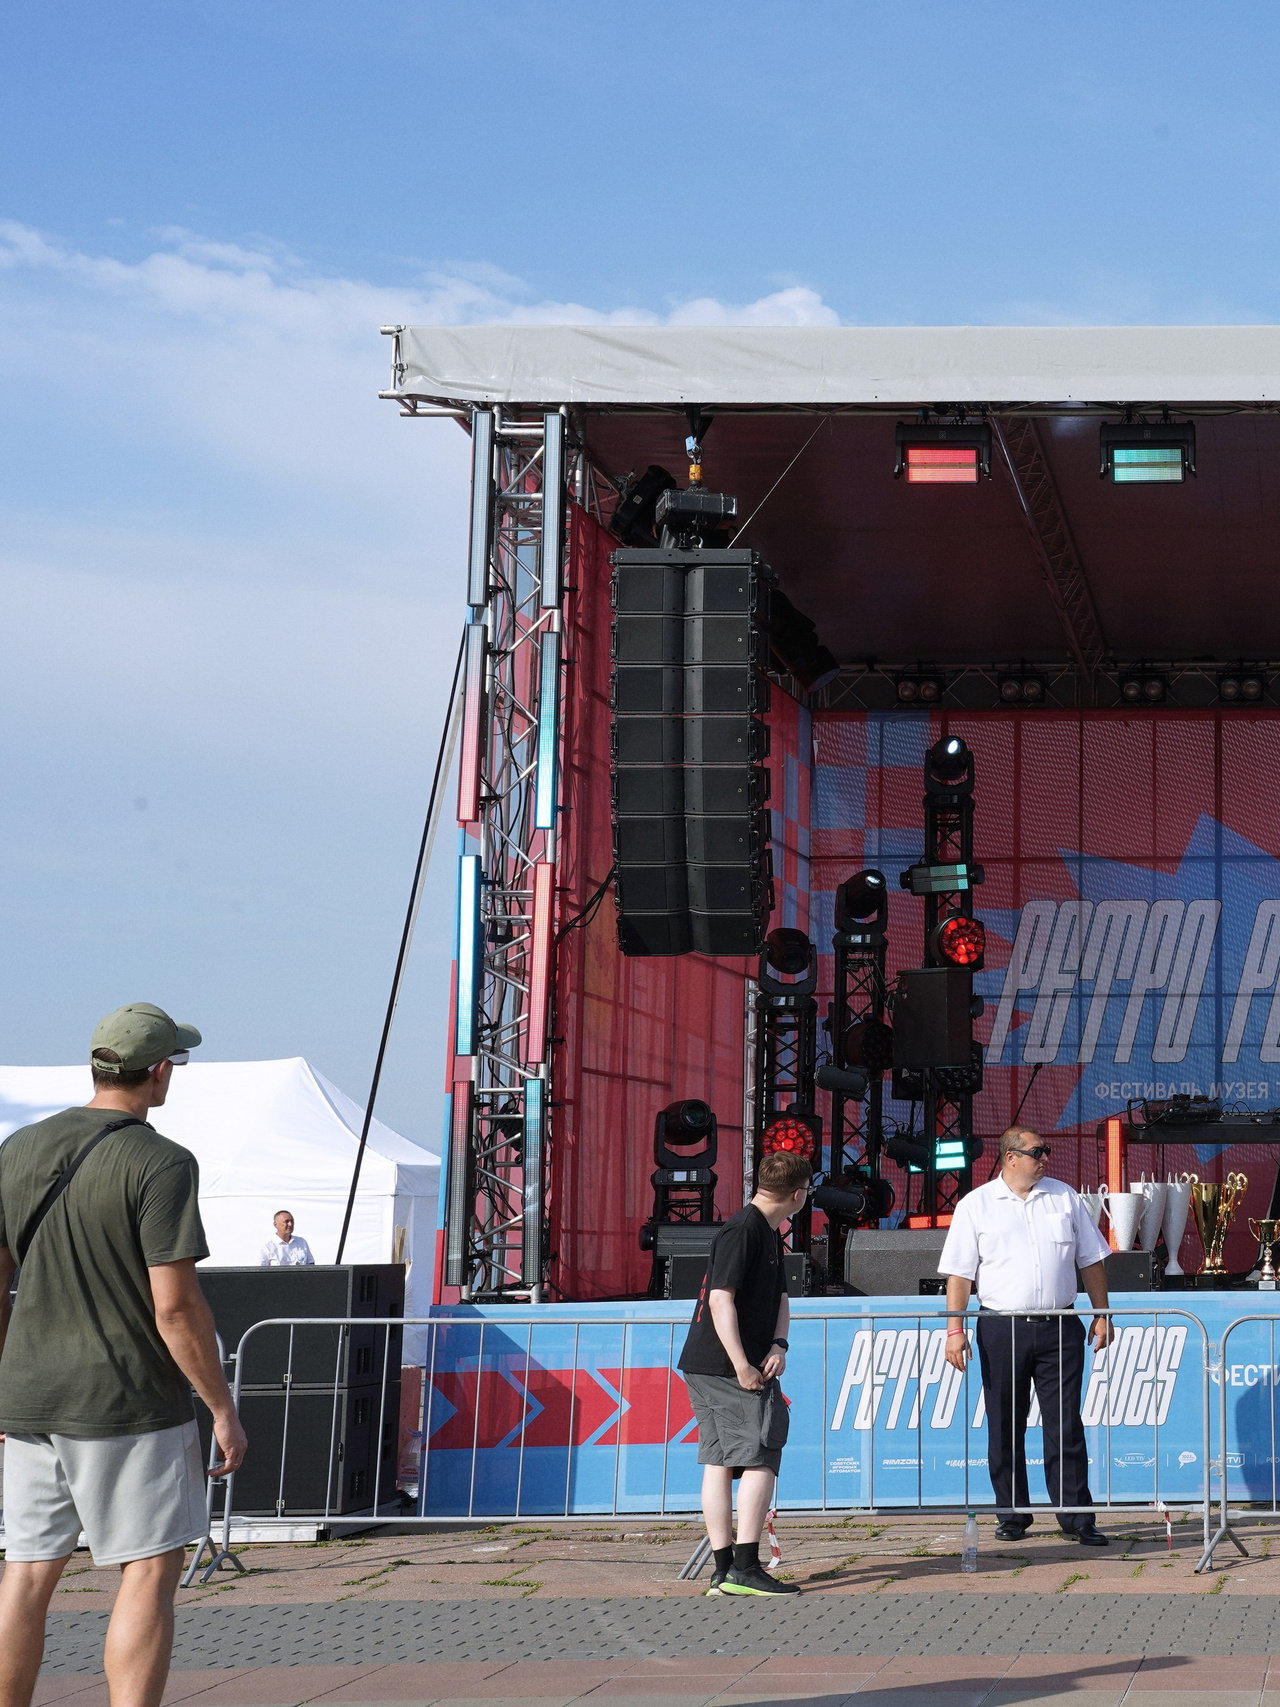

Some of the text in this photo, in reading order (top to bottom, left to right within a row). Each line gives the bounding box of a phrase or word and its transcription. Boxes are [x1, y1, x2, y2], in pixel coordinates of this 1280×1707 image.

[983, 899, 1223, 1064] РЕТРО
[1094, 1081, 1202, 1100] ФЕСТИВАЛЬ
[1209, 1081, 1269, 1100] МУЗЕЯ
[1083, 1325, 1188, 1427] 2025
